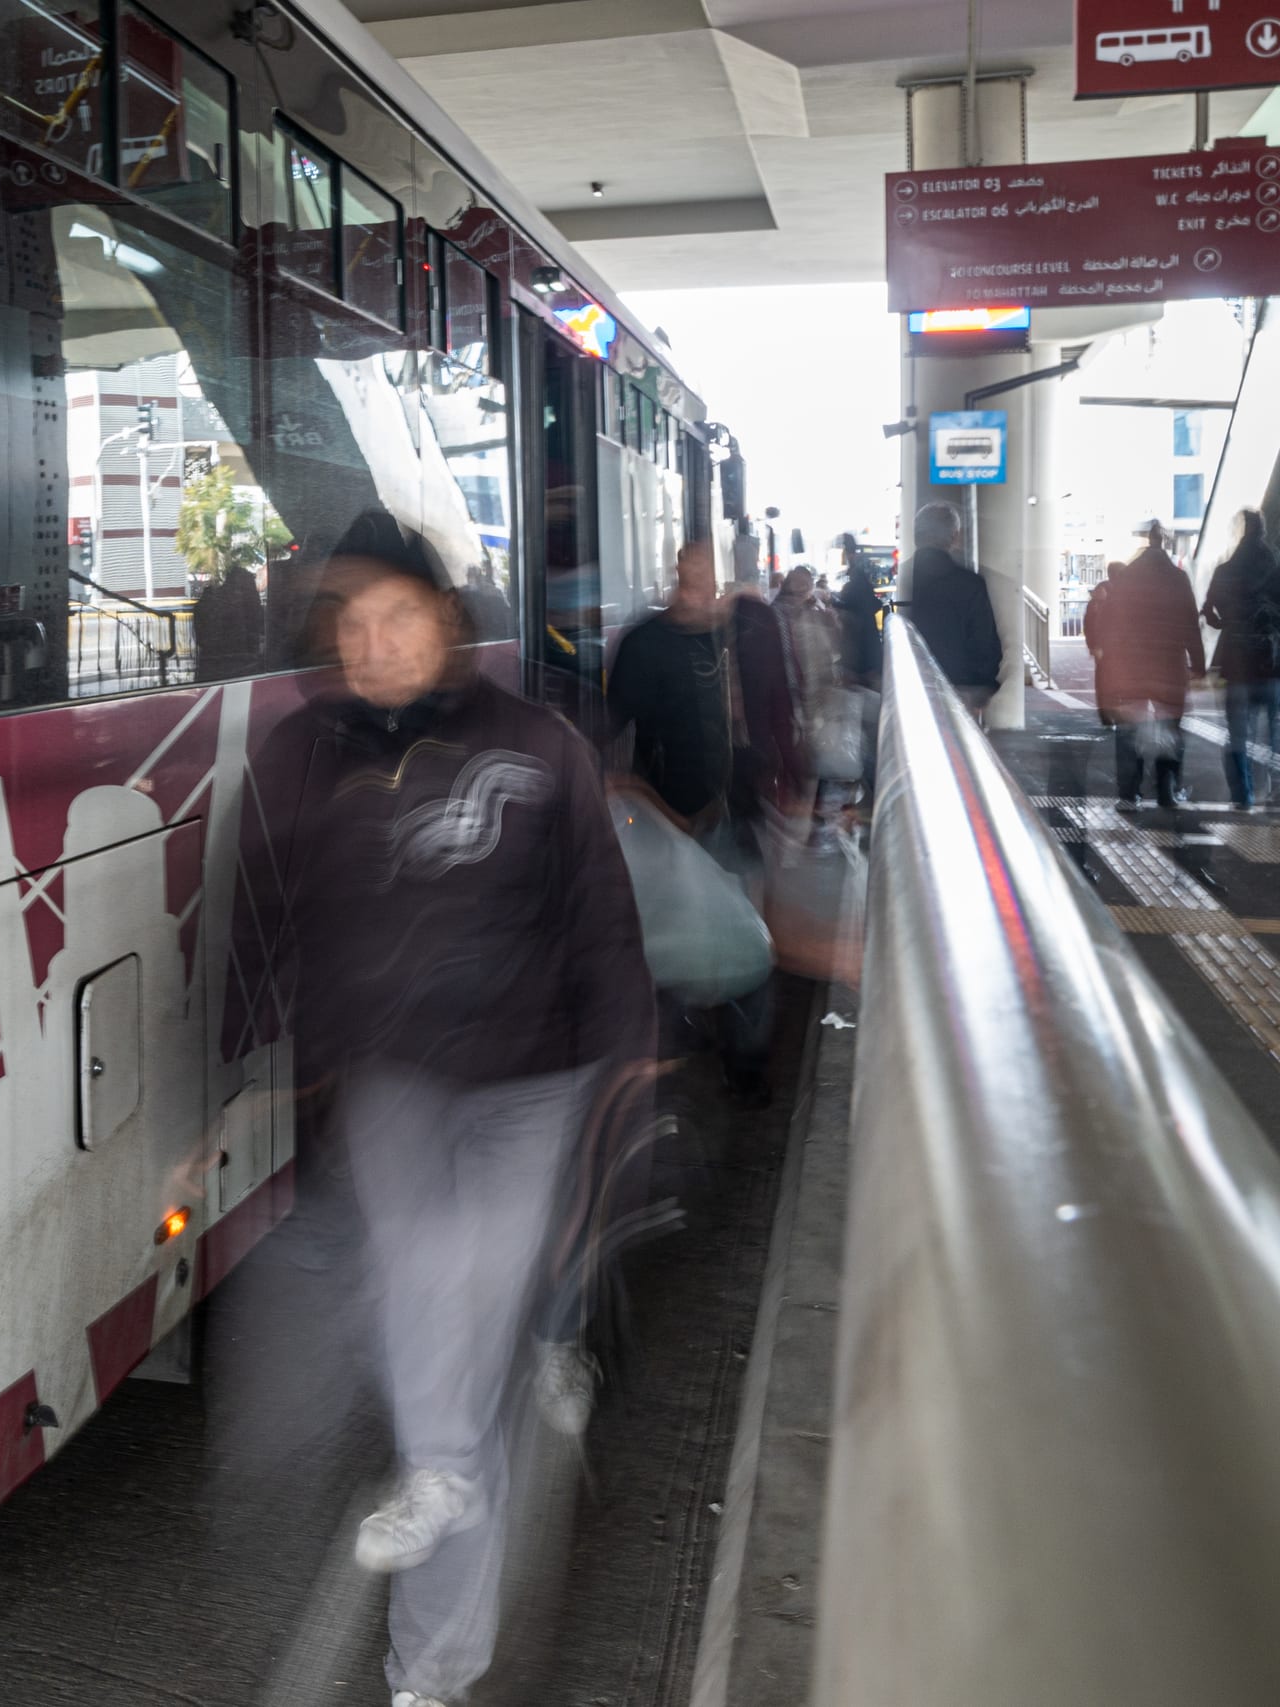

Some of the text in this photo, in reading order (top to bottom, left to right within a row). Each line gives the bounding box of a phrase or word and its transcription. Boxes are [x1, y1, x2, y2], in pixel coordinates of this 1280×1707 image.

[1152, 164, 1203, 180] TICKETS
[922, 177, 980, 193] ELEVATOR
[922, 205, 987, 222] ESCALATOR
[1177, 215, 1206, 231] EXIT
[1214, 213, 1251, 231] مخرج
[1035, 260, 1070, 275] LEVEL
[938, 469, 999, 479] BUS STOP
